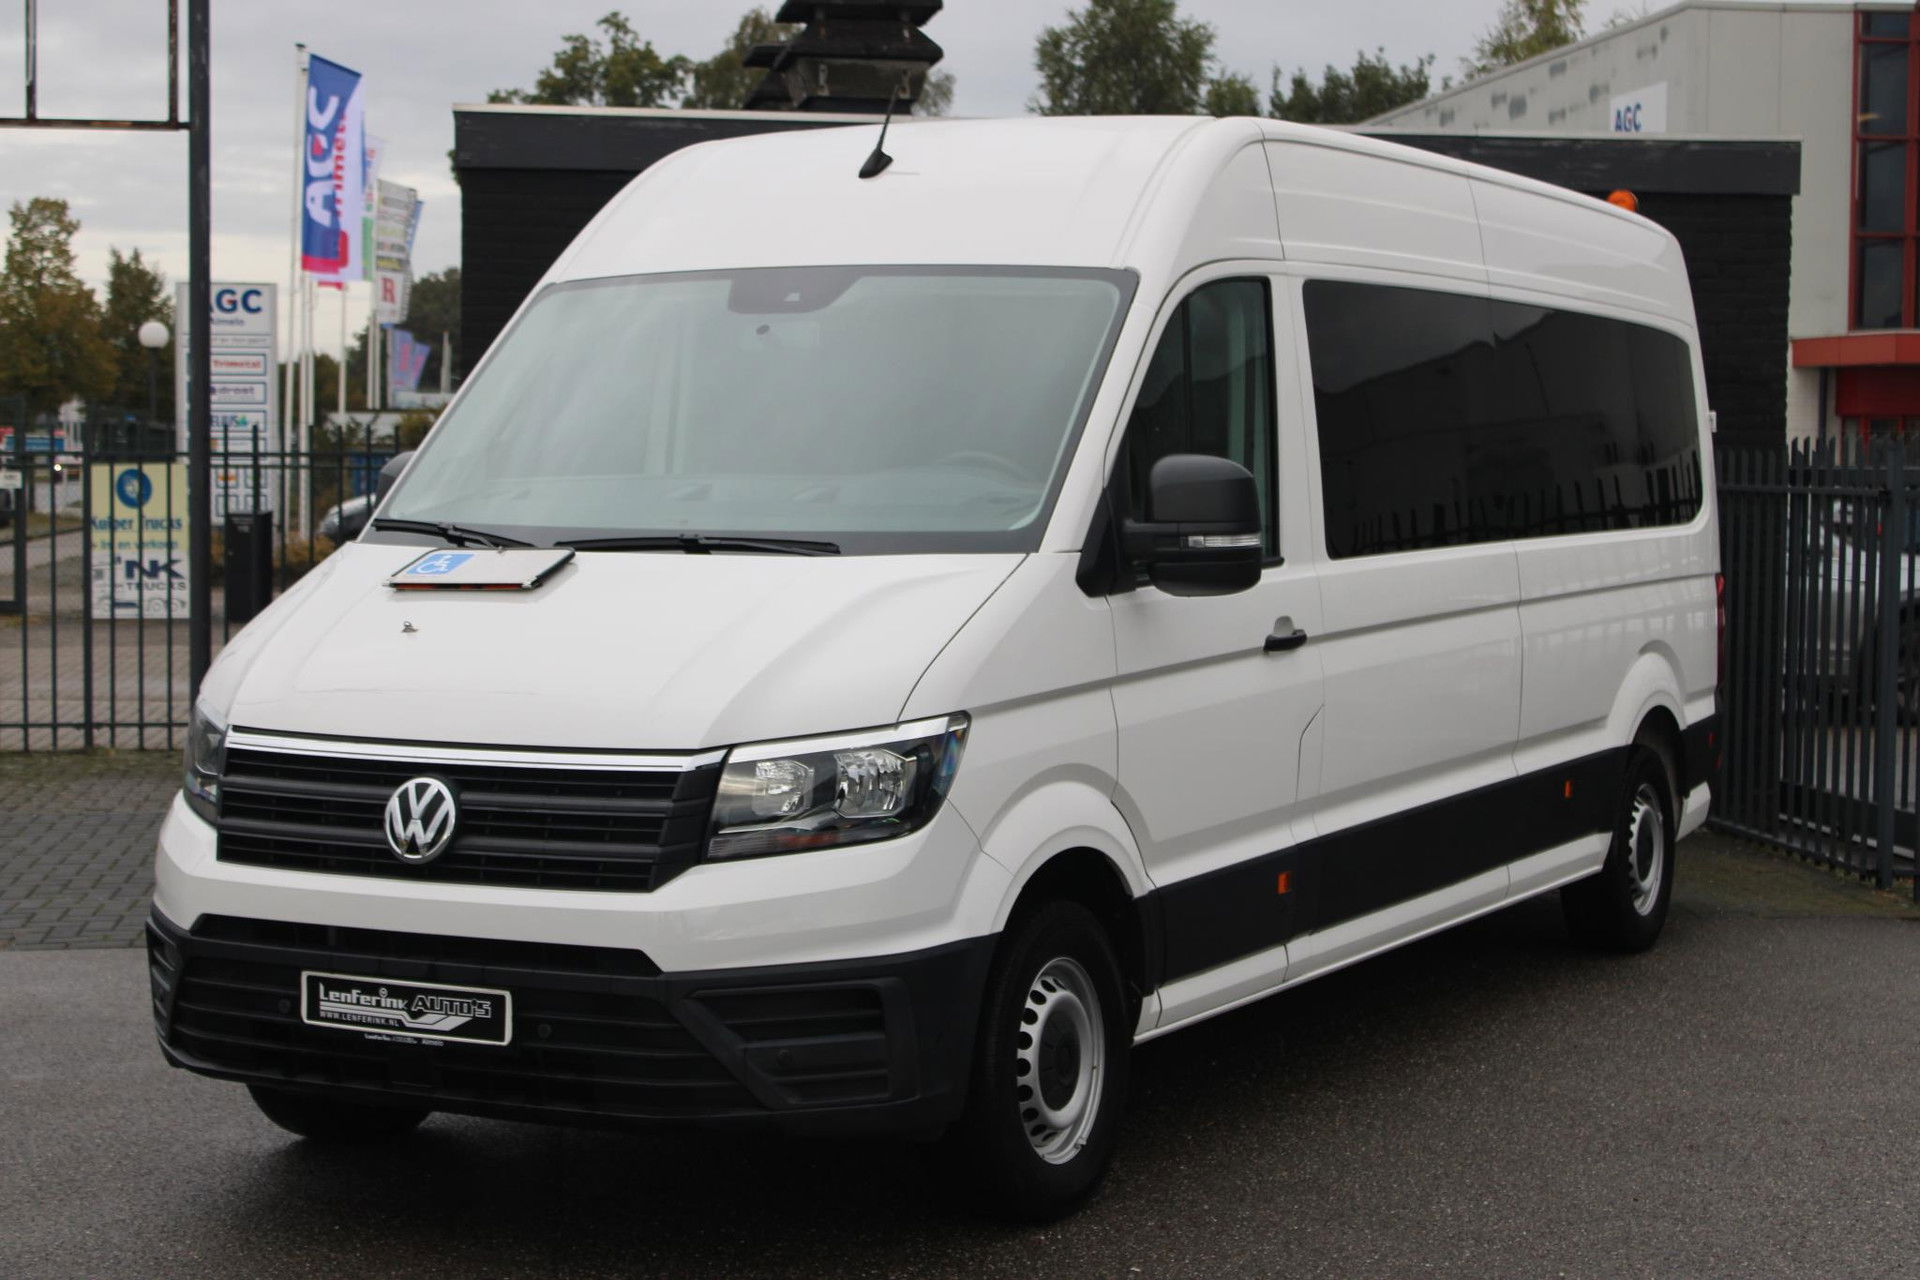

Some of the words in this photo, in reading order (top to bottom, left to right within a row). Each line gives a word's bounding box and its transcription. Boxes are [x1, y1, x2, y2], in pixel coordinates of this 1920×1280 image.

[1615, 102, 1642, 133] AGC
[306, 86, 340, 228] AGC
[210, 288, 263, 314] GC
[319, 1010, 400, 1028] WWW.LENFERINK.NL
[411, 995, 492, 1018] AUTO'S
